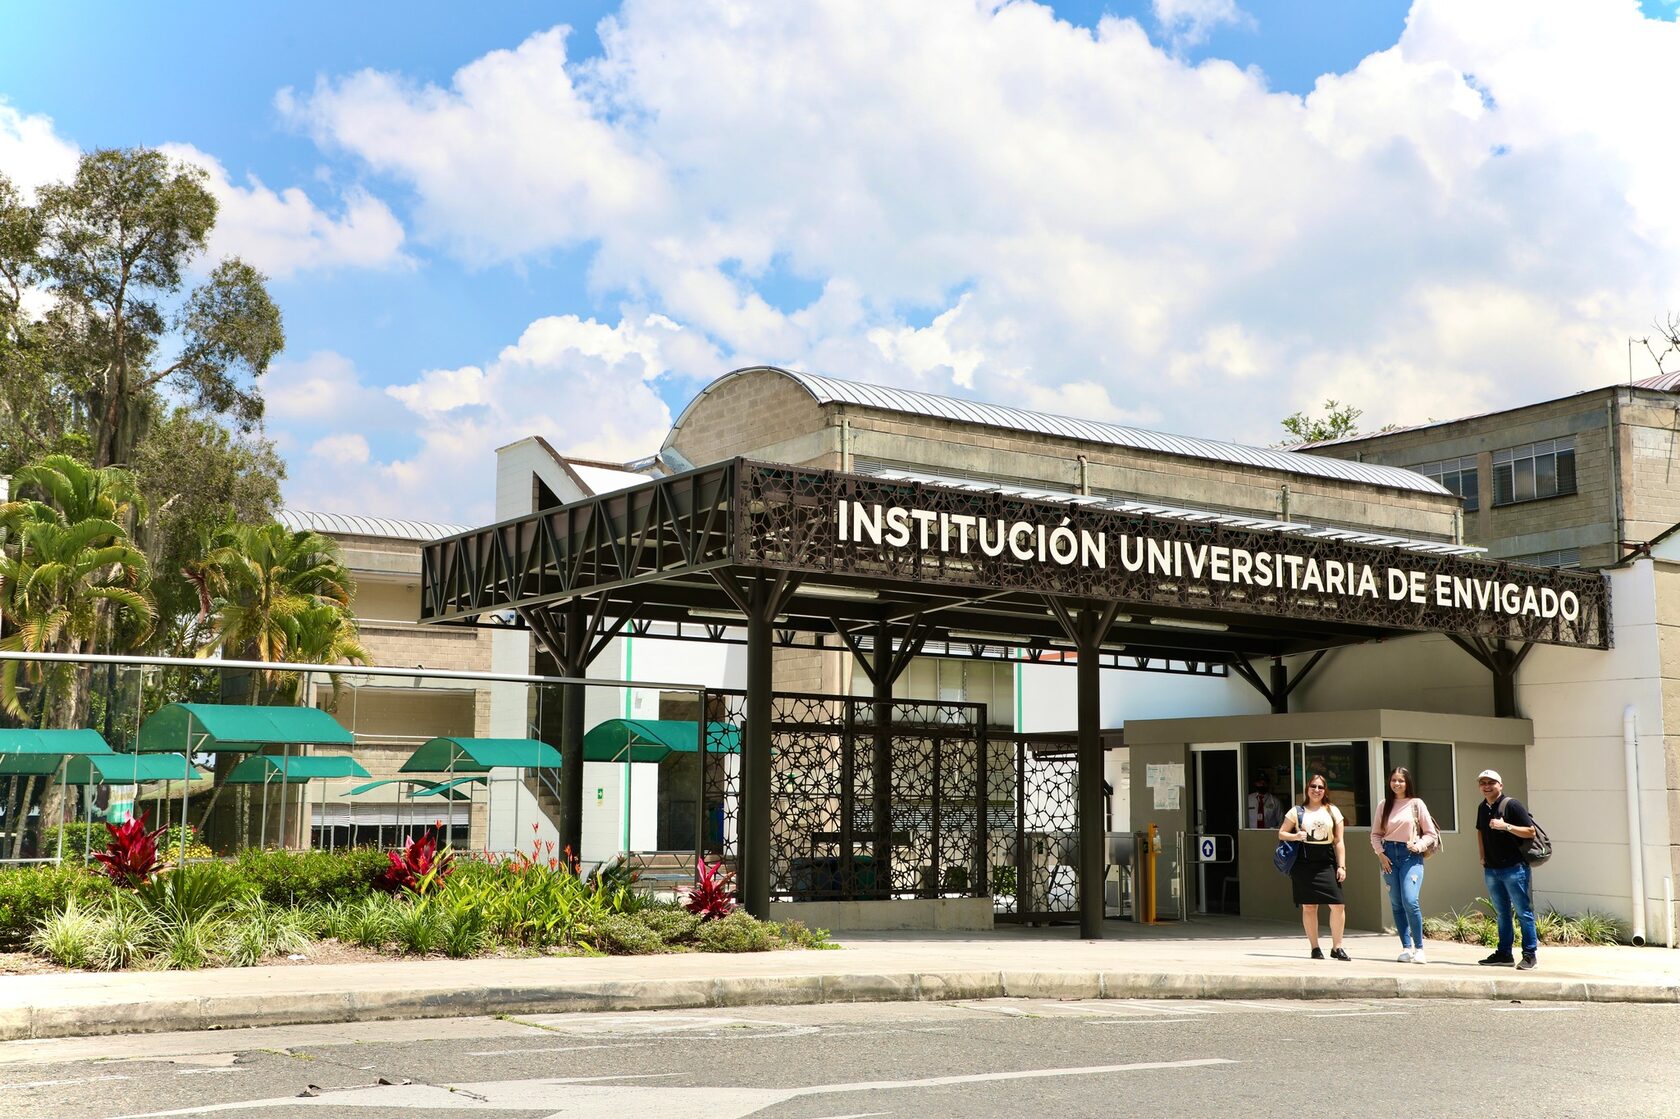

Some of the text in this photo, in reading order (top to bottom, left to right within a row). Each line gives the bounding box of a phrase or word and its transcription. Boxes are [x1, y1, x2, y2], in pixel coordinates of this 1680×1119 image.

[838, 499, 1580, 622] INSTITUCIÓN UNIVERSITARIA DE ENVIGADO
